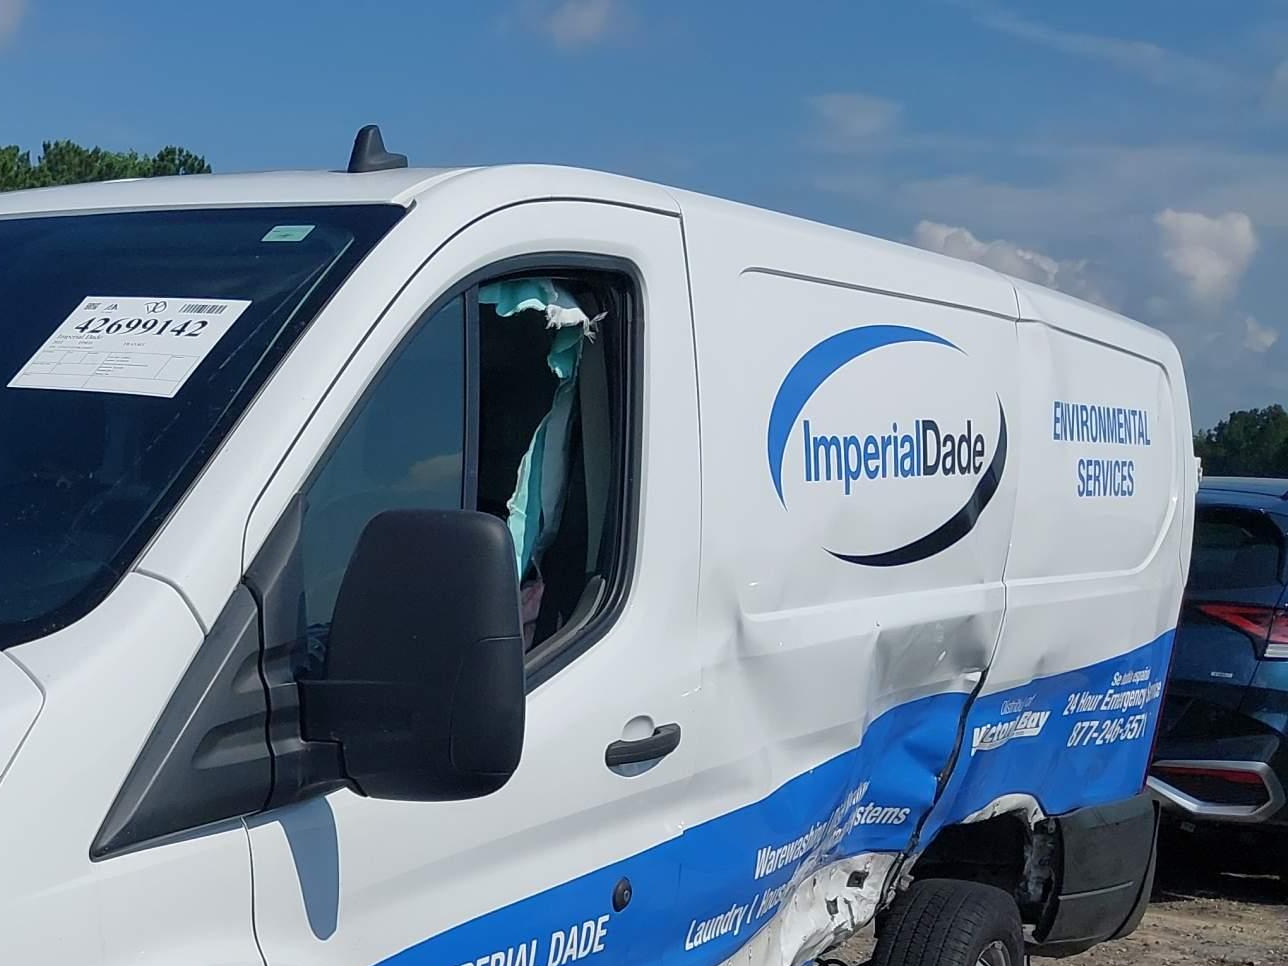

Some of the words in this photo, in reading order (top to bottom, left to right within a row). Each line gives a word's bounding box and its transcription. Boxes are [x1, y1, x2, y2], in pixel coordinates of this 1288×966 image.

[74, 317, 209, 337] 42699142
[1053, 401, 1151, 445] ENVIRONMENTAL
[803, 419, 985, 496] ImperialDade
[1077, 459, 1134, 497] SERVICES
[1062, 692, 1081, 716] 24
[1075, 690, 1104, 713] Hour
[685, 903, 750, 951] Laundry
